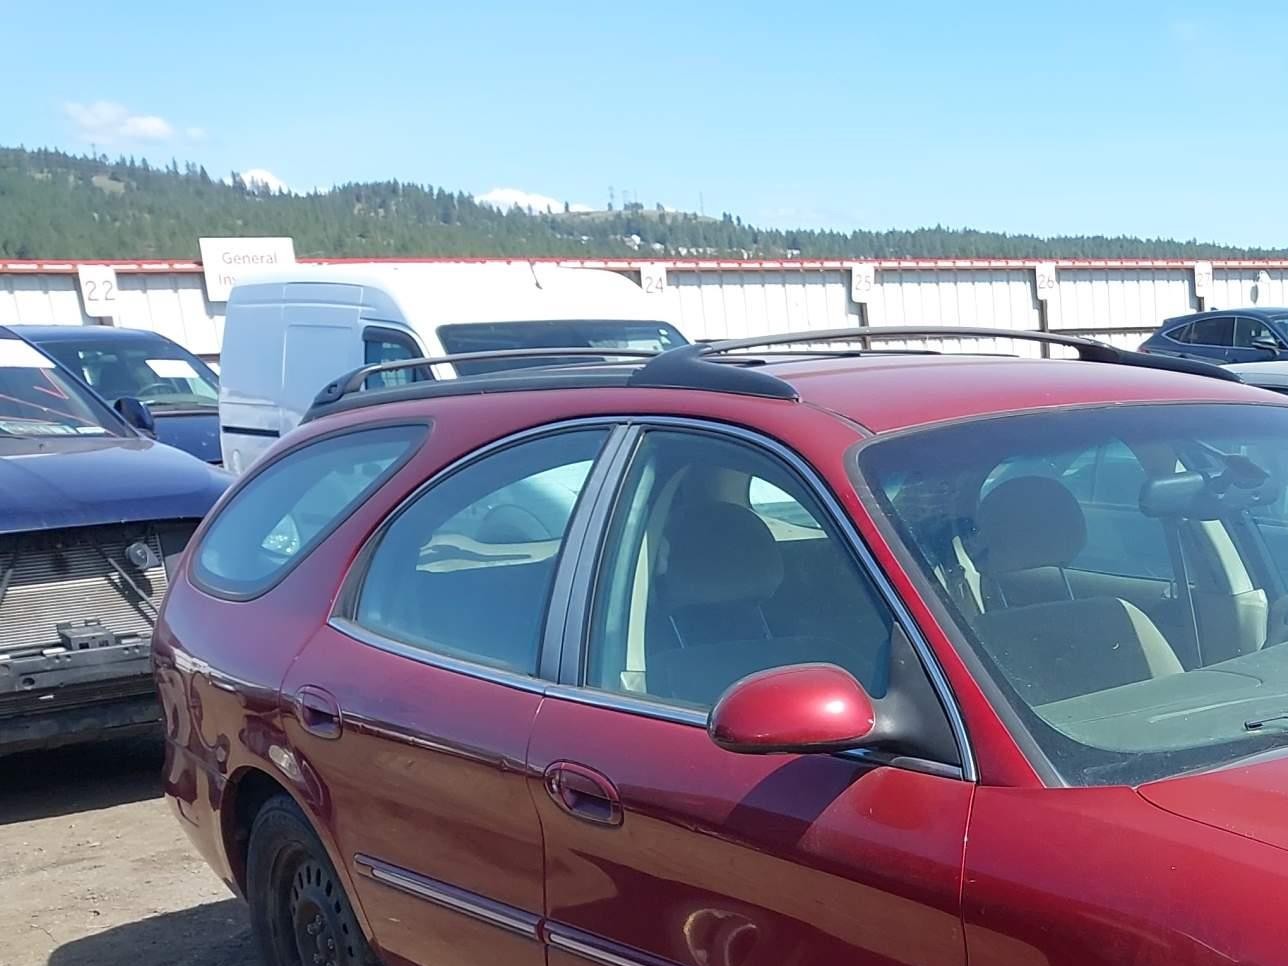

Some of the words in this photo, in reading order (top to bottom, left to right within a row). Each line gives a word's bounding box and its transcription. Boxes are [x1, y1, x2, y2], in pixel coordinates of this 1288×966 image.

[222, 251, 278, 265] General
[645, 276, 664, 293] 24
[855, 274, 871, 291] 25
[1038, 273, 1055, 289] 26
[85, 280, 116, 301] 22
